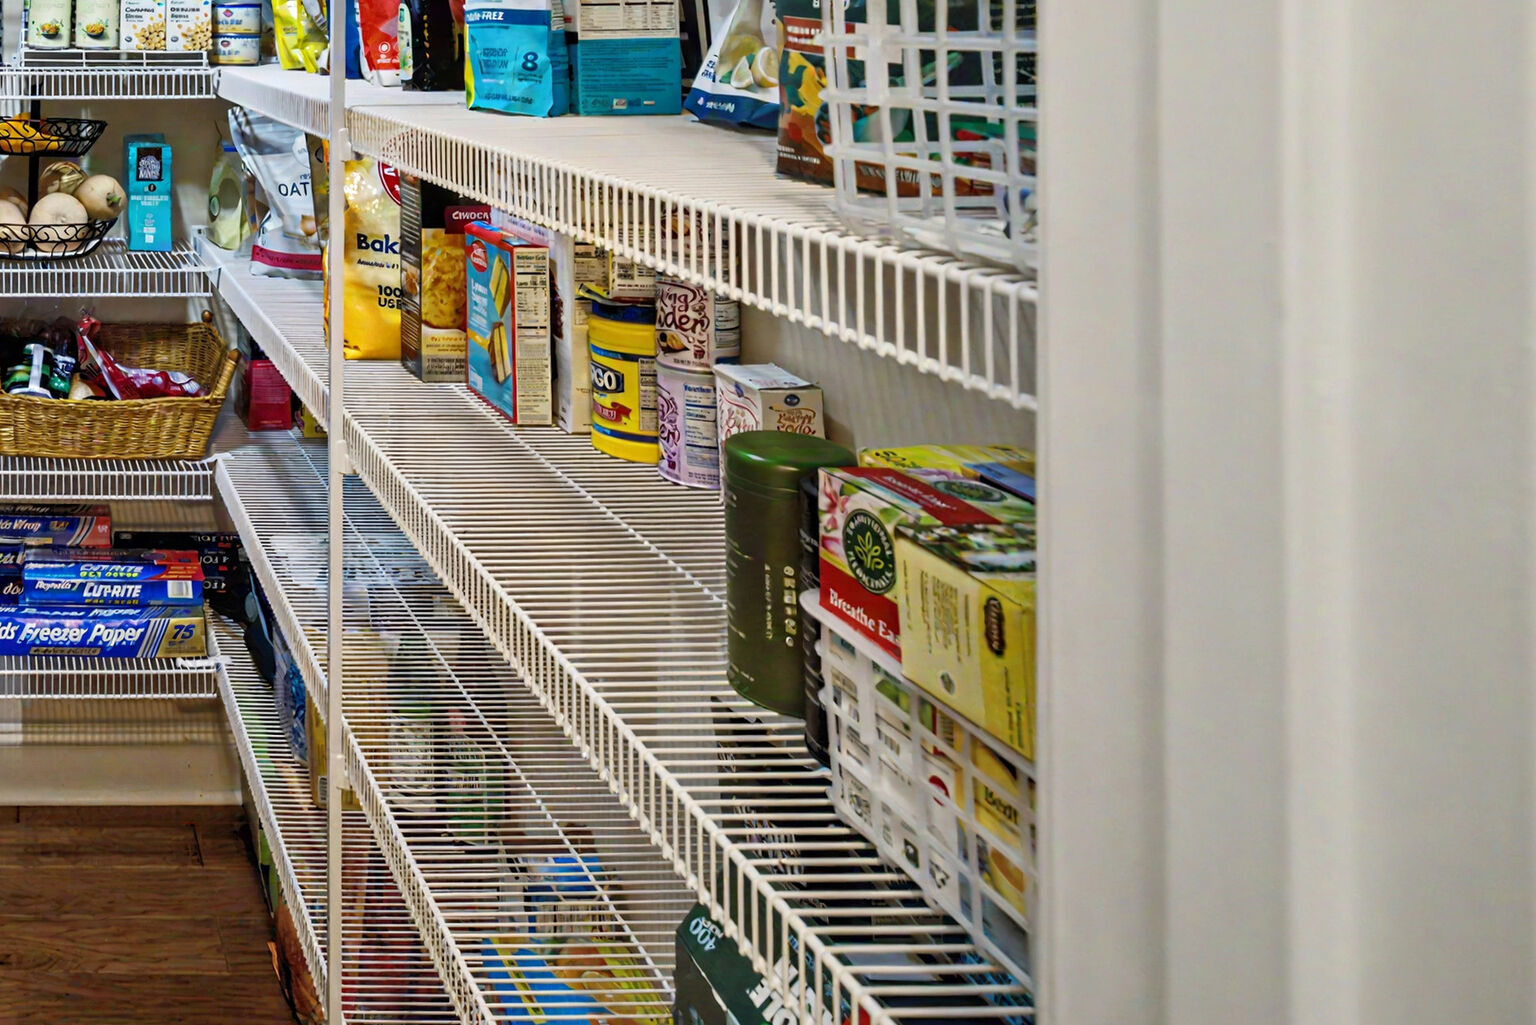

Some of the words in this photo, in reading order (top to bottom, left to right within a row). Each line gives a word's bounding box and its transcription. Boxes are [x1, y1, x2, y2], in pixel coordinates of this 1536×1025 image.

[521, 52, 539, 72] 8
[829, 587, 876, 633] Breathe
[17, 623, 89, 645] Freezer
[86, 624, 146, 645] Paper
